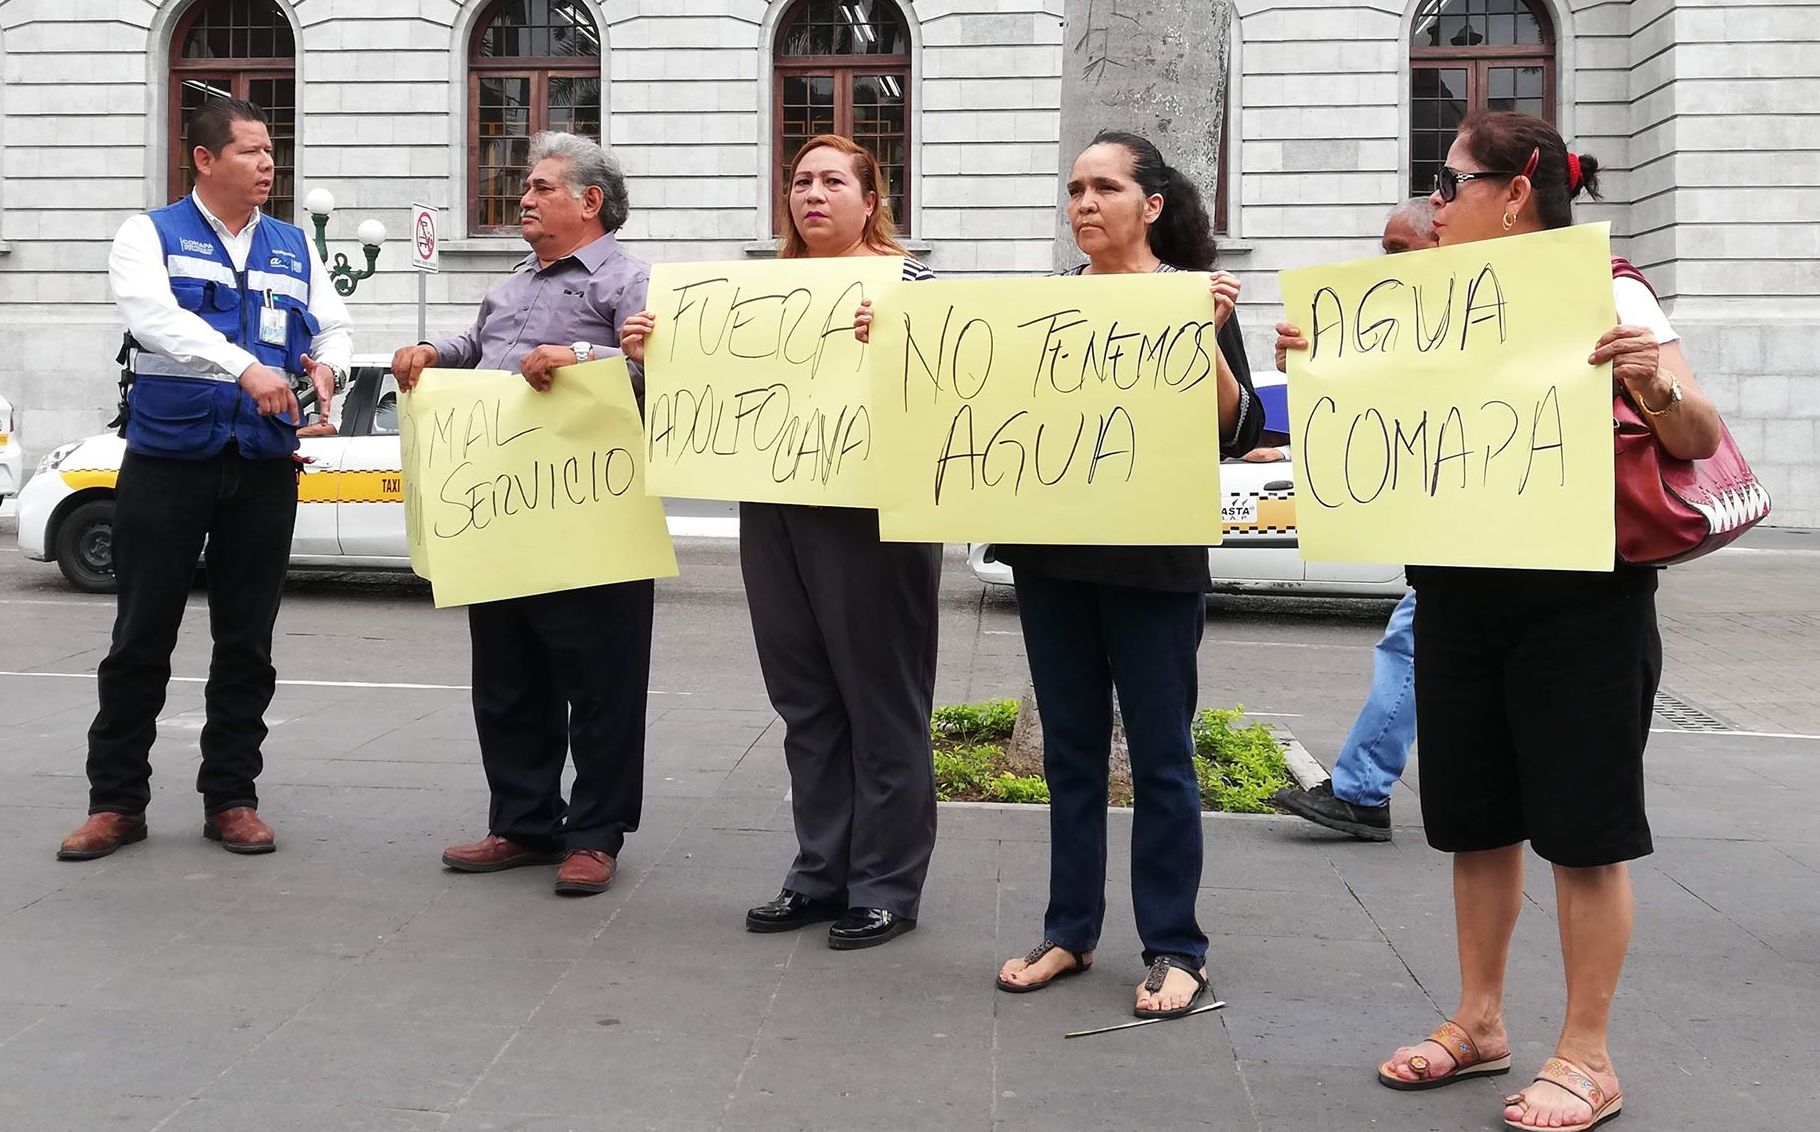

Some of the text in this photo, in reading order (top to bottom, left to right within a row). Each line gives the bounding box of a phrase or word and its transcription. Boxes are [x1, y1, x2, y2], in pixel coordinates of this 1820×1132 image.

[670, 277, 866, 380] FUERA
[903, 304, 1213, 412] NO TENEMOS
[1310, 262, 1508, 363] AGUA
[429, 398, 543, 469] MAL
[649, 383, 791, 466] ADOLFO
[935, 404, 1135, 506] AGUA
[1303, 385, 1565, 508] COMAPA
[382, 479, 400, 493] TAXI
[434, 447, 635, 538] SERVICIO
